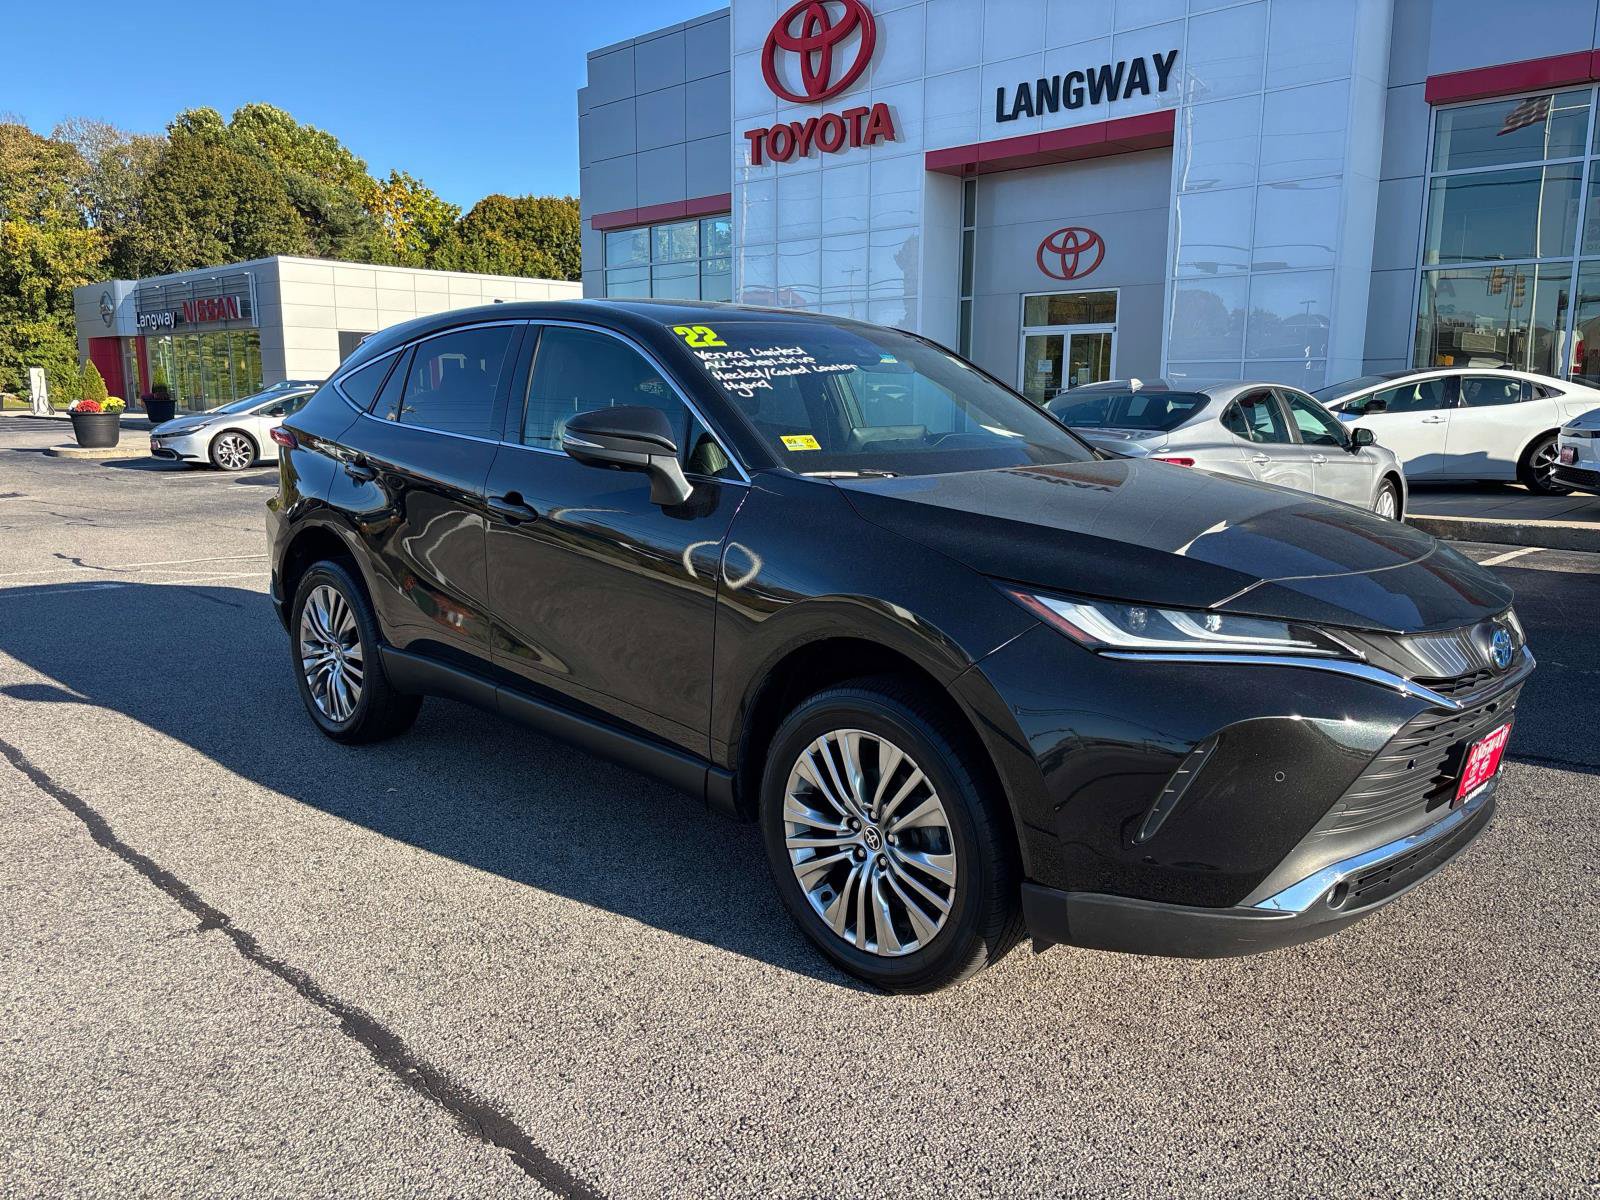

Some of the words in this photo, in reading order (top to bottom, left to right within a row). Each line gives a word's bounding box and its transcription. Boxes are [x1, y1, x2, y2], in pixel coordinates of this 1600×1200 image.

[996, 49, 1178, 123] LANGWAY
[744, 102, 896, 166] TOYOTA
[136, 311, 175, 330] Langway
[182, 295, 242, 323] NISSAN
[673, 326, 728, 348] 22
[723, 379, 773, 397] Hybrid
